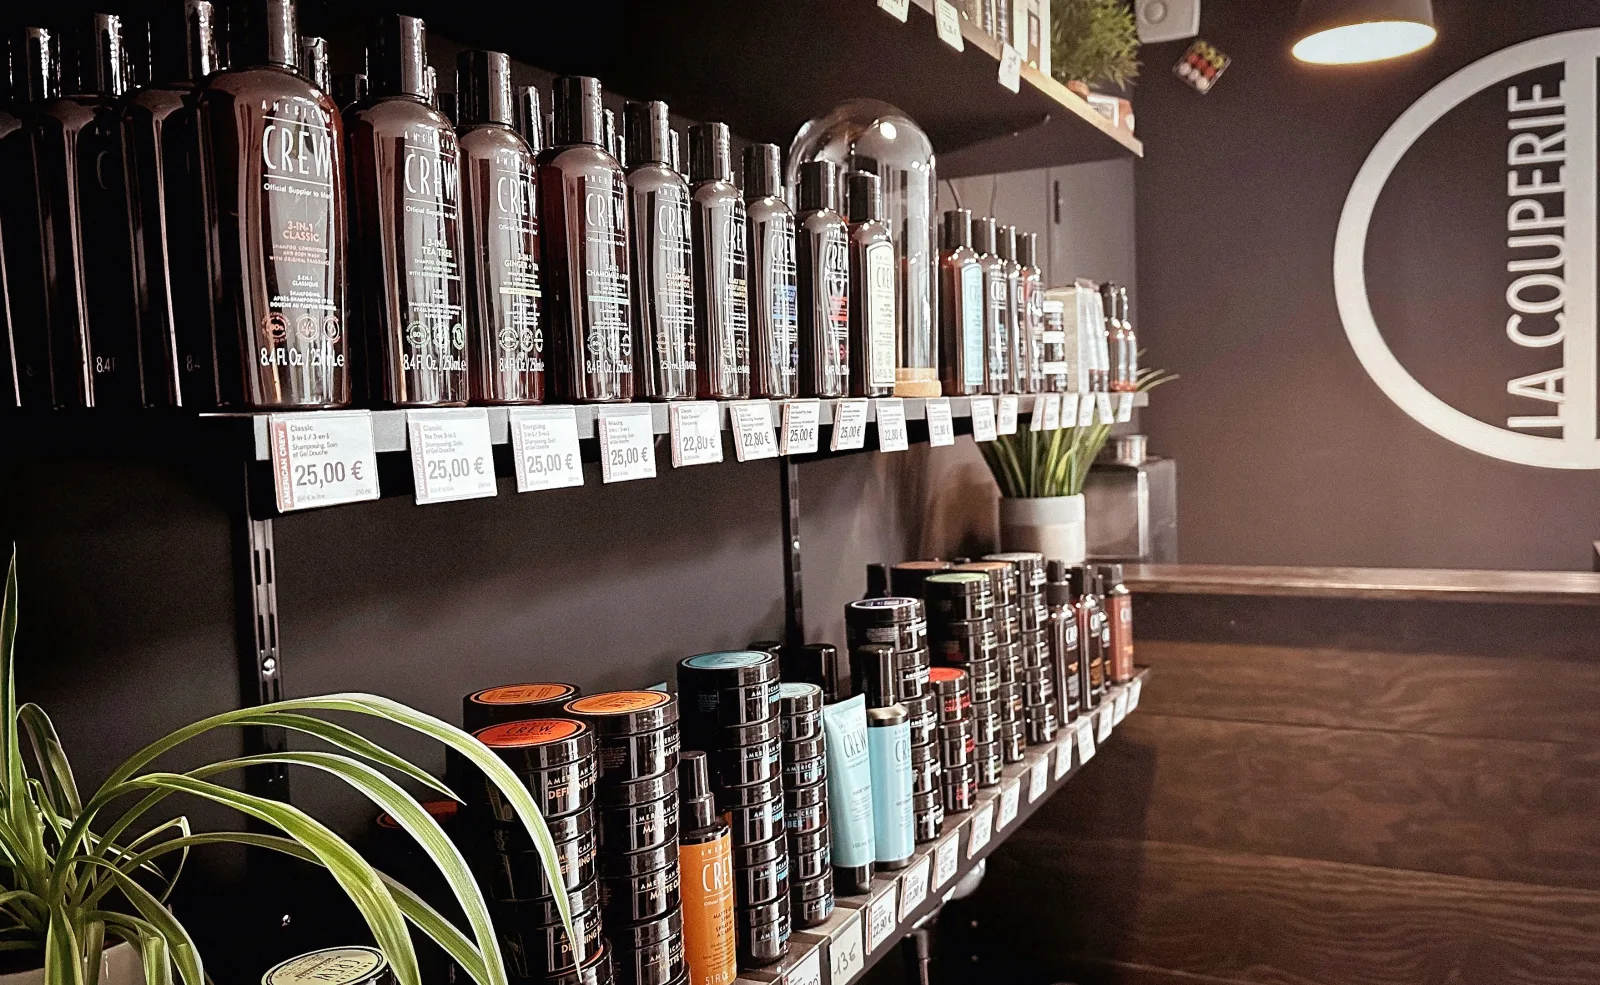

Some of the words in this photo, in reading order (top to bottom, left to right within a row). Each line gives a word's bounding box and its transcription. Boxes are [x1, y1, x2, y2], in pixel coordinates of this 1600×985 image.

[262, 125, 331, 178] CREW
[405, 153, 455, 201] CREW
[263, 182, 287, 193] Official
[288, 186, 312, 197] Supplier
[497, 176, 536, 219] CREW
[586, 193, 625, 231] CREW
[1505, 80, 1566, 349] COUPERIE
[287, 221, 313, 232] 3-IN-1
[282, 230, 319, 242] CLASSIC
[421, 246, 437, 256] TEA
[437, 247, 453, 258] TREE
[504, 259, 528, 270] GINGER
[1506, 366, 1565, 429] LA
[290, 424, 314, 432] Classic
[423, 424, 443, 432] Classic
[790, 428, 808, 443] 25,00
[809, 428, 814, 440] €
[840, 426, 857, 441] 25,00
[857, 425, 862, 437] €
[278, 429, 288, 456] CREW
[683, 435, 708, 453] 22,80
[743, 431, 764, 449] 22,80
[764, 431, 771, 444] €
[309, 449, 329, 457] Douche
[611, 447, 639, 468] 25,00
[641, 446, 648, 462] €
[427, 457, 470, 482] 25,00
[473, 456, 485, 475] €
[526, 453, 562, 476] 25,00
[565, 453, 574, 470] €
[281, 460, 291, 504] AMERICAN
[295, 461, 345, 489] 25,00
[350, 460, 364, 480] €
[843, 727, 868, 758] CREW
[786, 761, 816, 772] AMERIC
[548, 779, 588, 800] DEFING
[643, 818, 668, 835] MAE
[785, 820, 804, 829] BER
